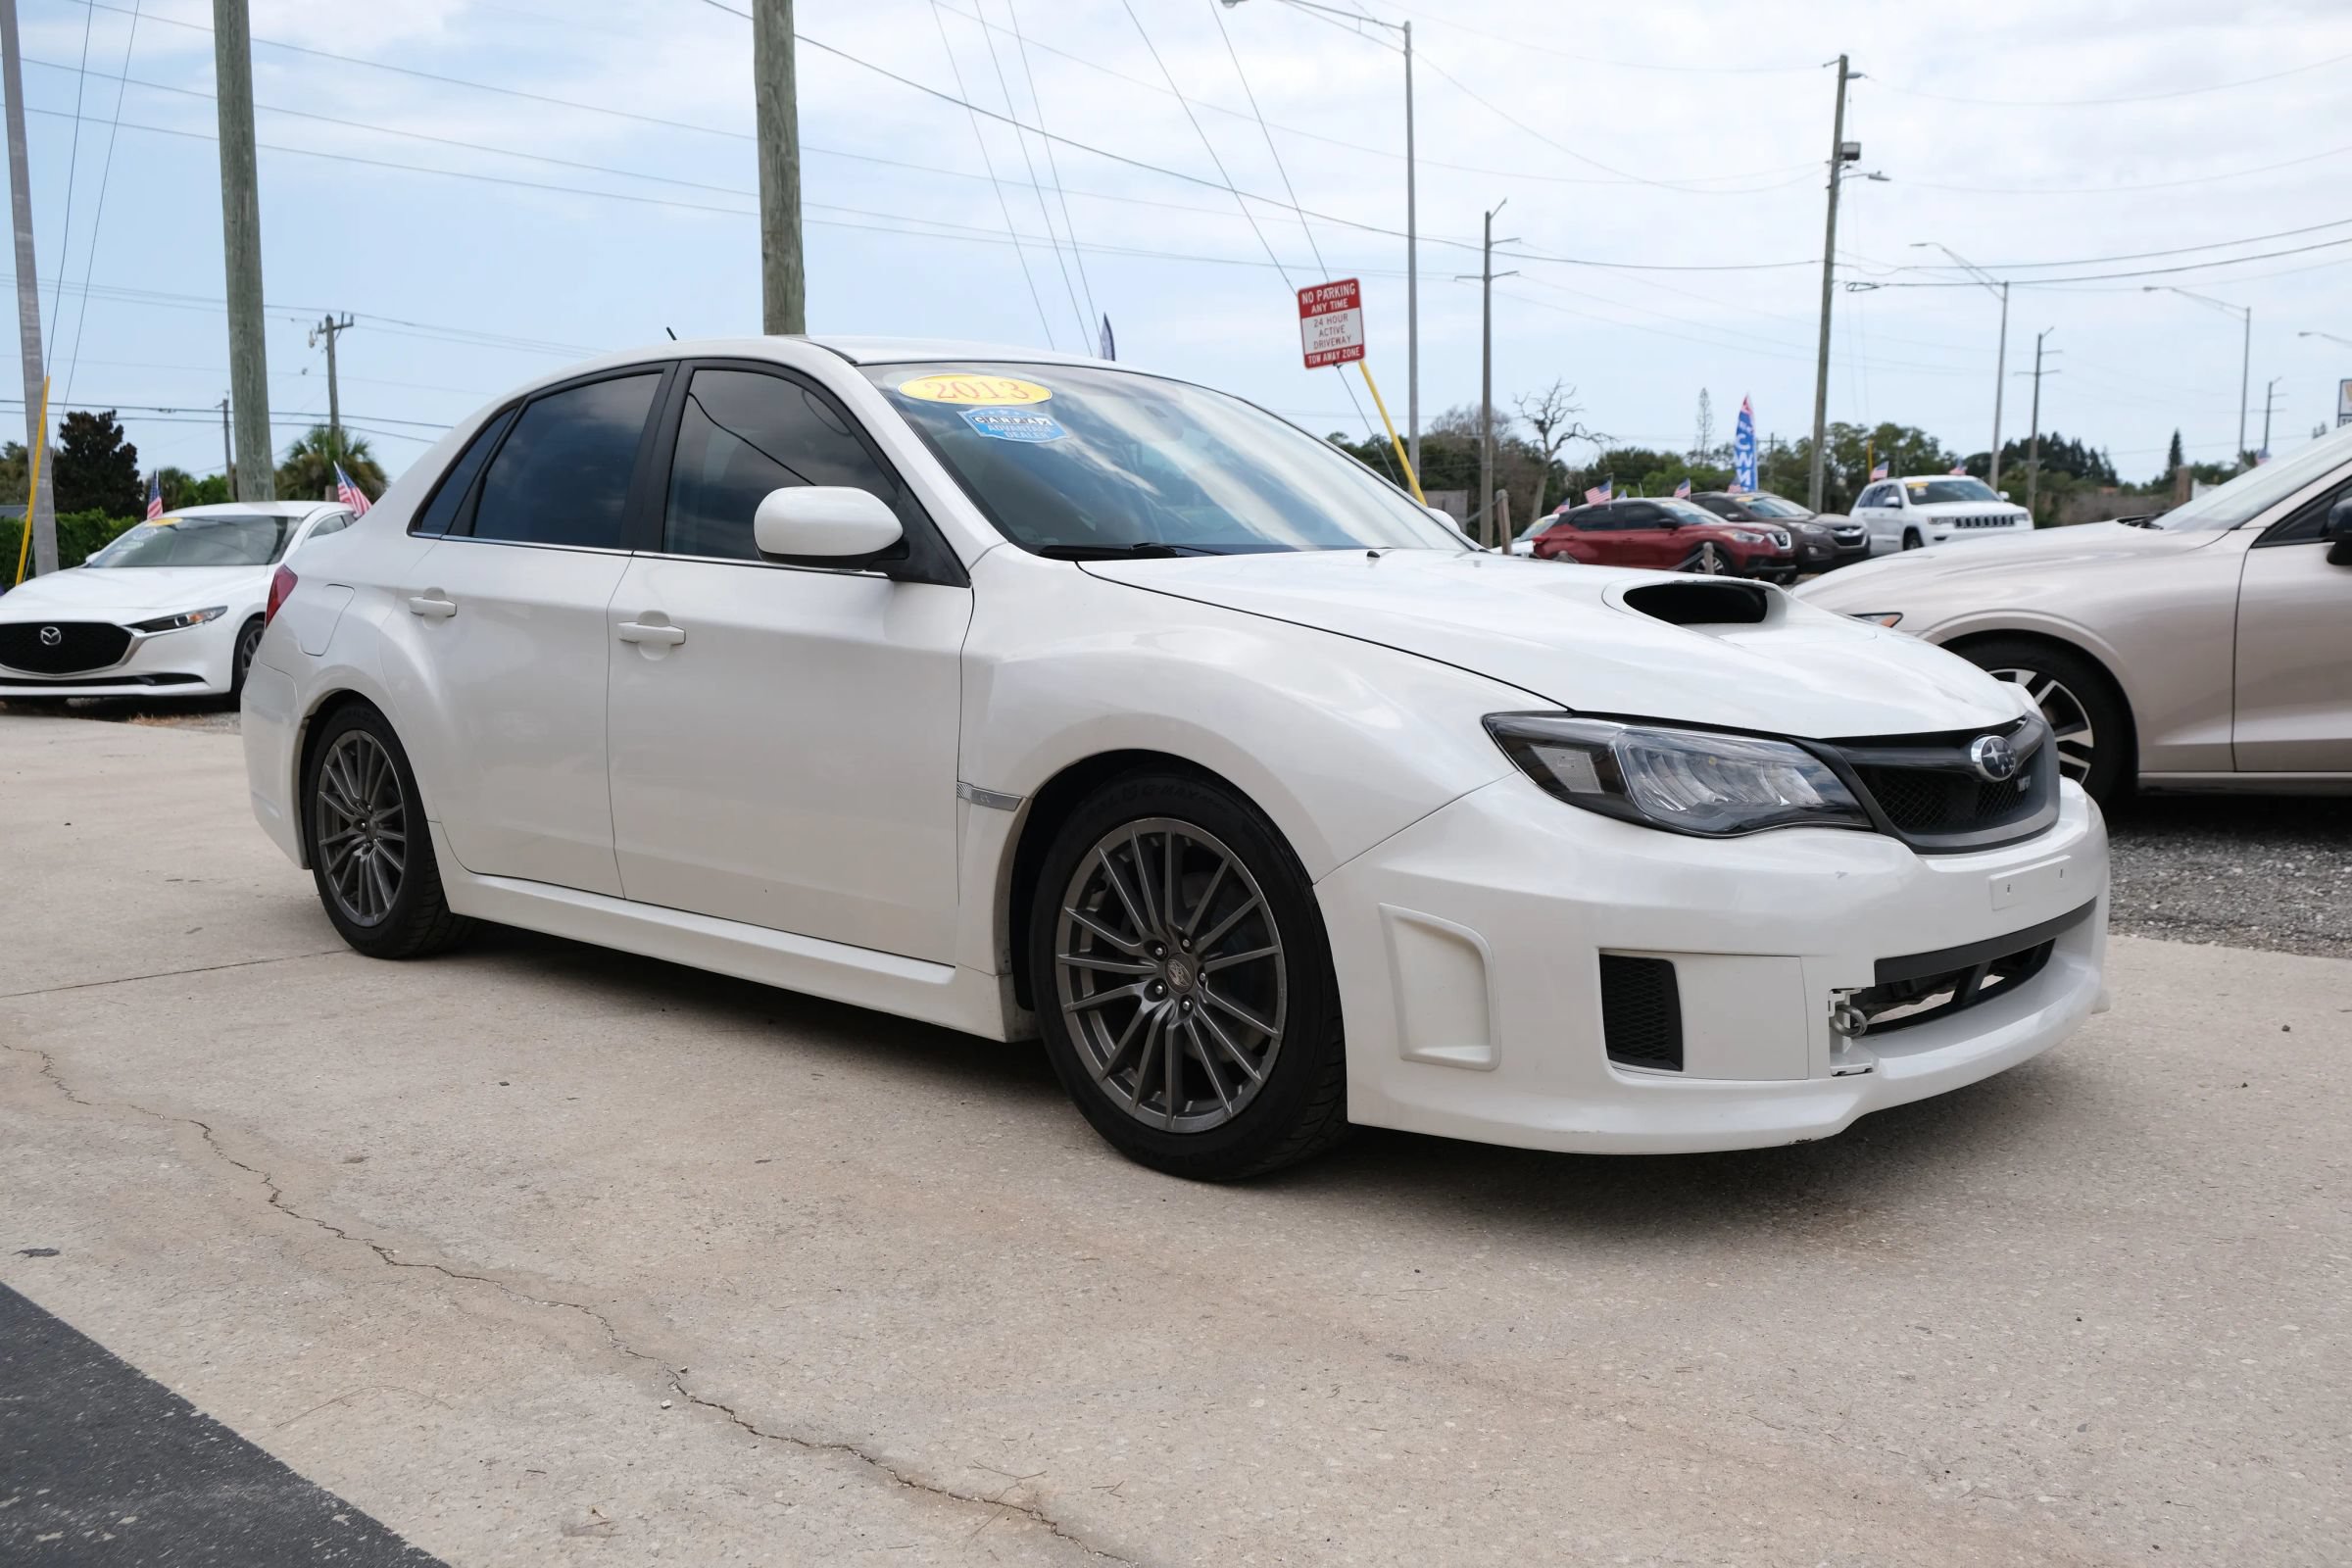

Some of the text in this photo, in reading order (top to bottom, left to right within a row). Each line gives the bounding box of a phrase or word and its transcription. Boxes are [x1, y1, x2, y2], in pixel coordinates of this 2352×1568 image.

[1301, 283, 1355, 305] NO PARKING
[1311, 298, 1348, 314] ANY TIME
[1327, 314, 1348, 325] HOUR
[1319, 324, 1346, 337] ACTIVE
[1313, 335, 1351, 350] DRIVEWAY
[1308, 347, 1360, 365] TOW AWAY ZONE
[924, 380, 1030, 401] 2013
